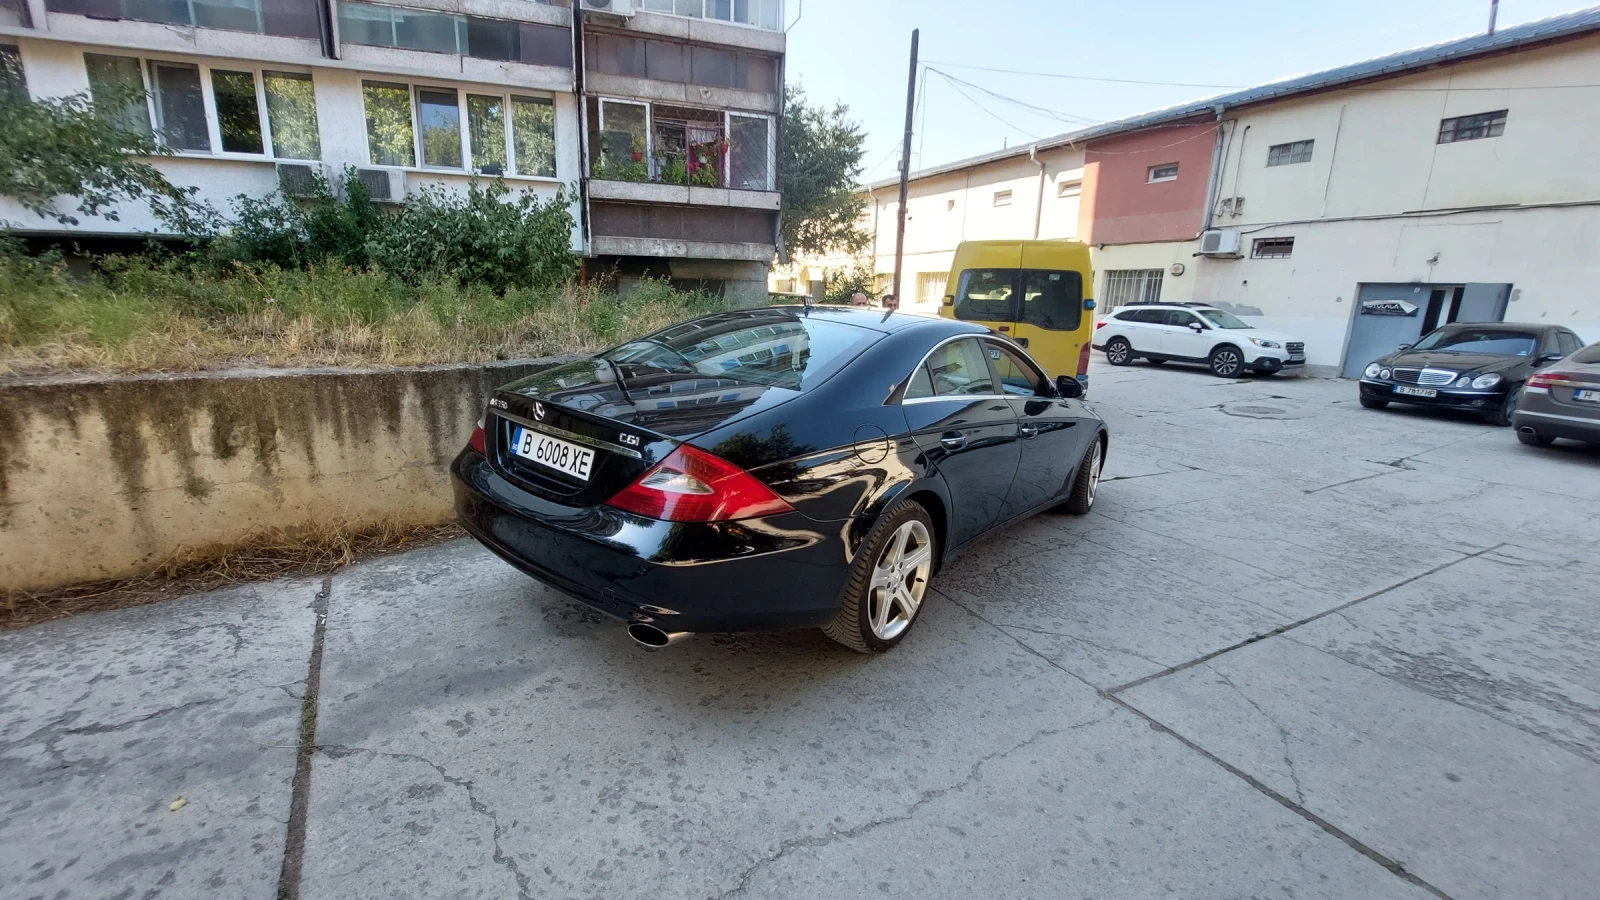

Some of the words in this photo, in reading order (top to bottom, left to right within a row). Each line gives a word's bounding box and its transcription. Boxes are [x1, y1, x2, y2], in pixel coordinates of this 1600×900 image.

[618, 432, 641, 447] CGI
[522, 433, 533, 455] B
[536, 438, 569, 468] 6008
[568, 447, 591, 477] XE
